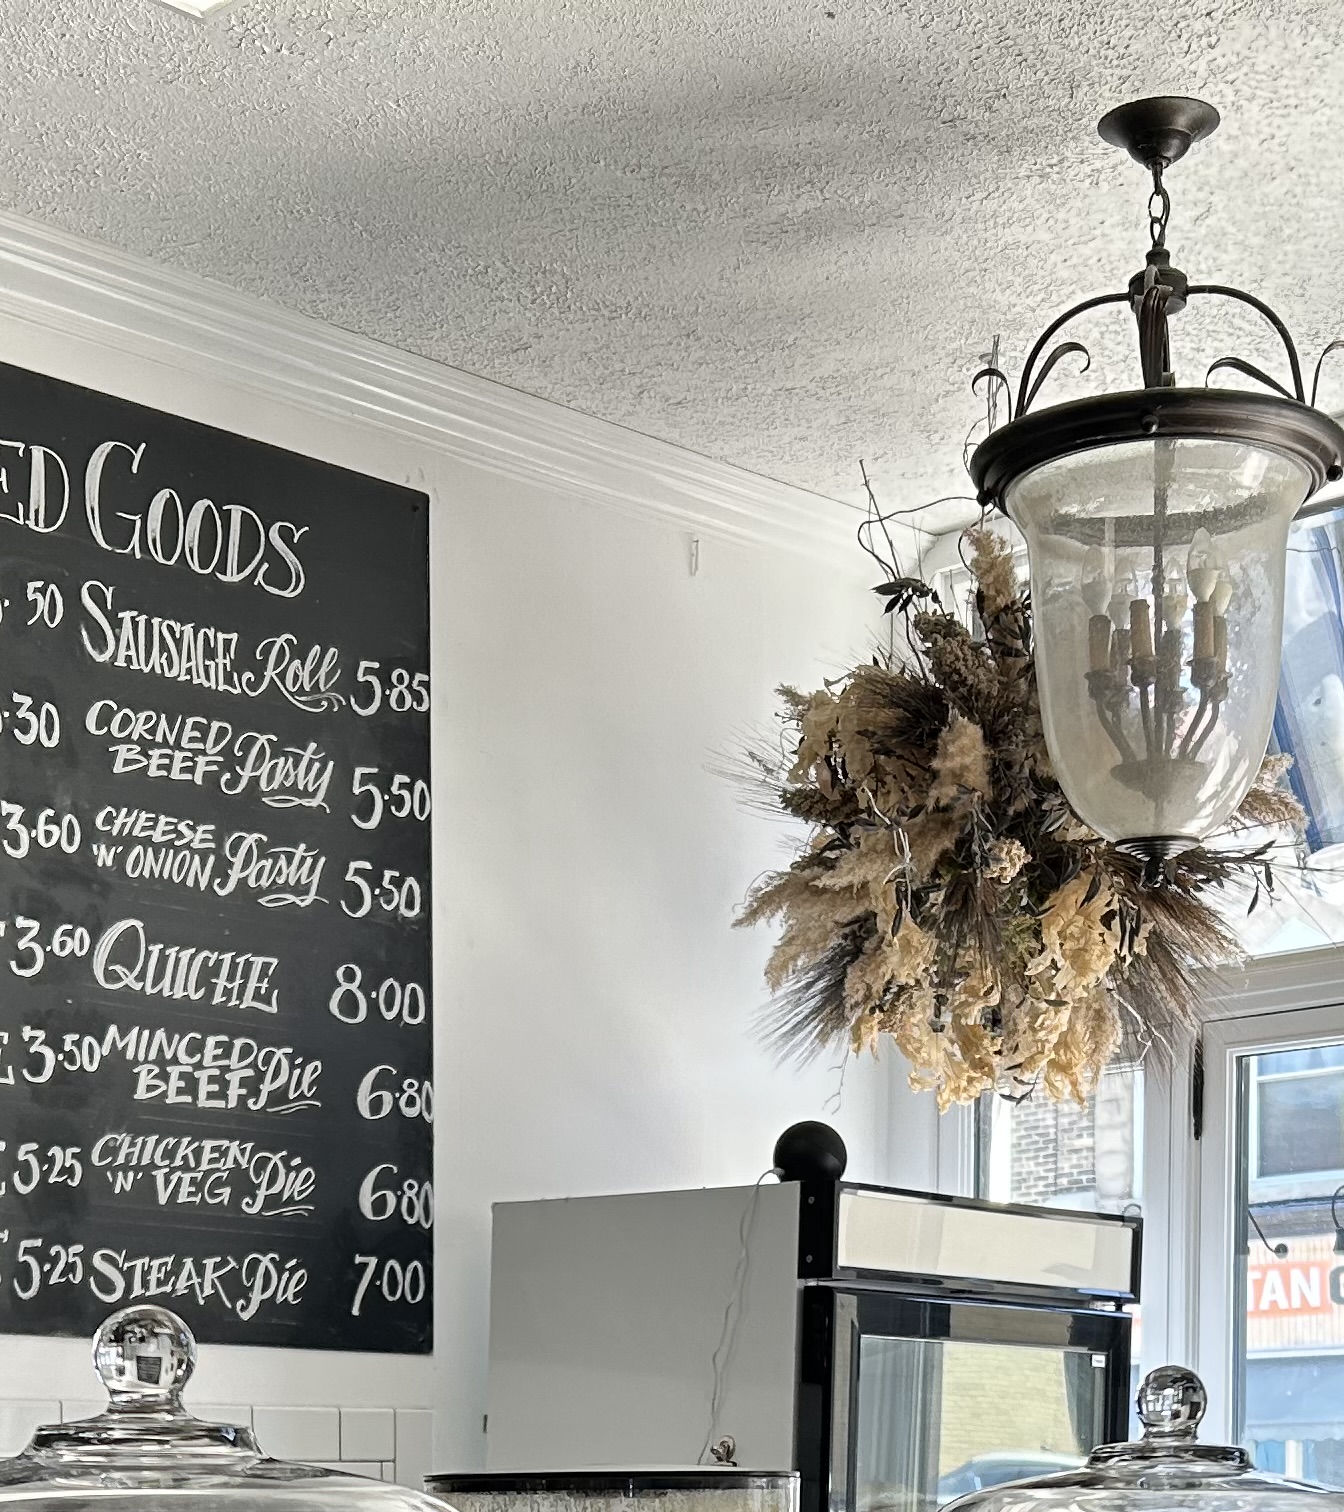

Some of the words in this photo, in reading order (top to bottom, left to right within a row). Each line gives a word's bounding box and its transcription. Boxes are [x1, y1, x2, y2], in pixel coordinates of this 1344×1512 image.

[85, 441, 309, 598] GOODS
[81, 580, 242, 695] SAUSAGE
[242, 633, 346, 712] Roll
[350, 660, 430, 716] 5.85
[85, 700, 232, 754] CORNED
[109, 744, 224, 785] BEEF
[220, 731, 335, 814] Pasty
[351, 767, 432, 830] 5.50
[1, 800, 81, 859] 3.60
[95, 805, 216, 849] CHEESE
[125, 845, 215, 891] ONION
[212, 832, 330, 907] Pasty
[340, 860, 422, 919] 5.50
[9, 916, 91, 979] 3.60
[92, 918, 279, 1014] QUICHE
[328, 963, 426, 1025] 8.00
[21, 1025, 101, 1084] 3.50
[102, 1024, 257, 1070] MINCED
[133, 1063, 256, 1109] BEEF
[247, 1047, 323, 1112] Pie
[356, 1064, 434, 1124] 6.80
[13, 1143, 83, 1195] 5.25
[91, 1133, 256, 1171] CHICKEN
[152, 1169, 231, 1206] VEG
[241, 1150, 316, 1216] Pie
[358, 1164, 434, 1230] 6.80
[13, 1239, 85, 1300] 5.25
[89, 1248, 240, 1309] STEAK
[236, 1252, 308, 1322] Pie
[351, 1253, 426, 1317] 7.00
